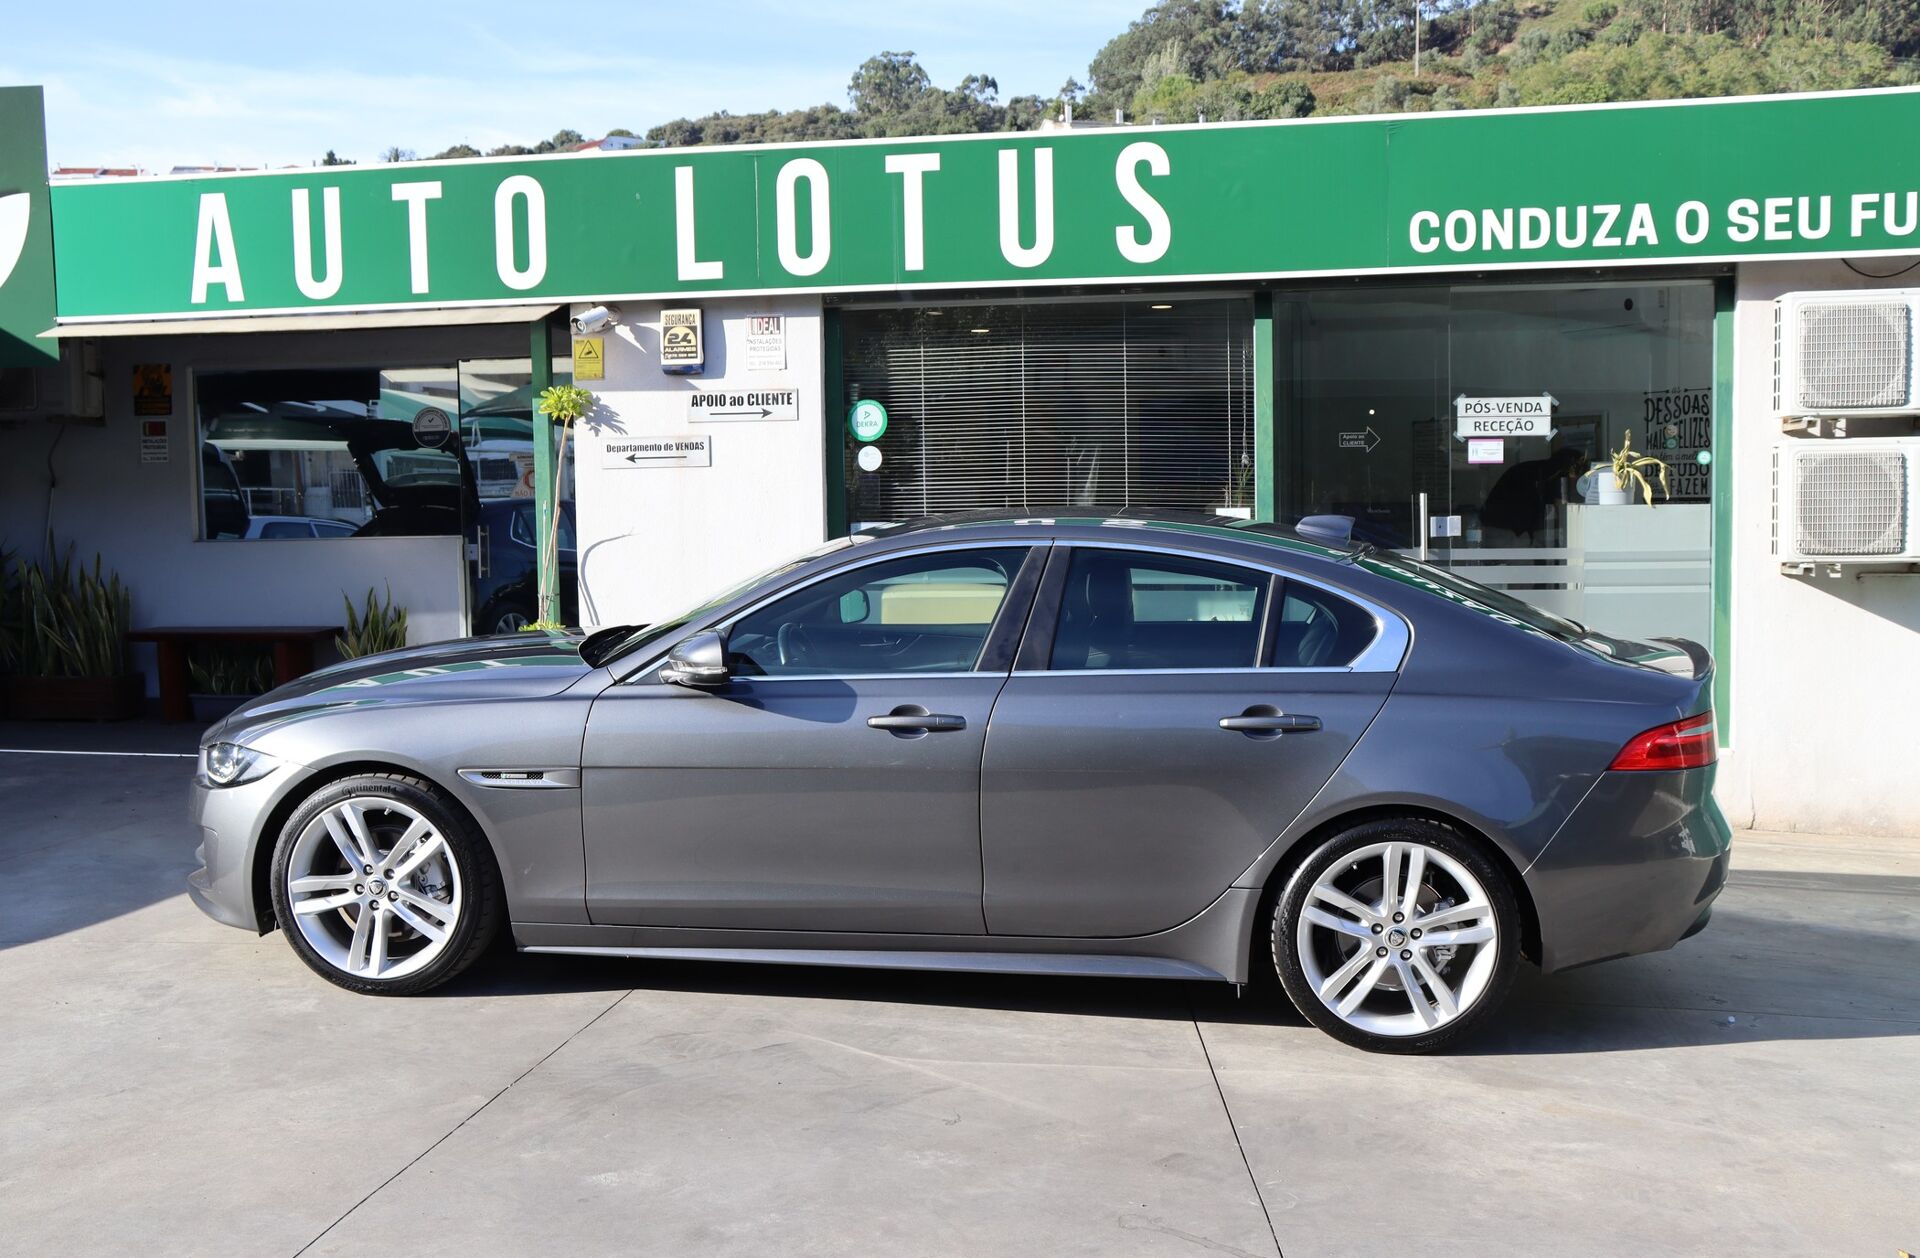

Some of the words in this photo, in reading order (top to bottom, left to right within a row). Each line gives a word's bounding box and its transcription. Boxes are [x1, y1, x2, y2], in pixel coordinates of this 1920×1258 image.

[190, 175, 548, 304] AUTO
[674, 141, 1171, 281] LOTUS
[1409, 202, 1659, 254] CONDUZA
[1675, 200, 1709, 244] O
[1726, 195, 1832, 242] SEU
[1850, 191, 1918, 237] FU
[667, 333, 692, 345] 24
[691, 393, 727, 407] APOIO
[729, 395, 744, 406] ao
[747, 392, 793, 406] CLIENTE
[1464, 399, 1543, 414] PÓS-VENDA
[1644, 394, 1710, 433] PESSOAS
[856, 420, 878, 428] DEKRA
[1473, 418, 1534, 434] RECEÇÃO
[1674, 417, 1711, 449] ELIZES
[606, 443, 662, 453] Departamento
[663, 442, 674, 452] de
[675, 441, 705, 452] VENDAS
[1670, 477, 1708, 495] FAZEM
[342, 783, 391, 797] Continental
